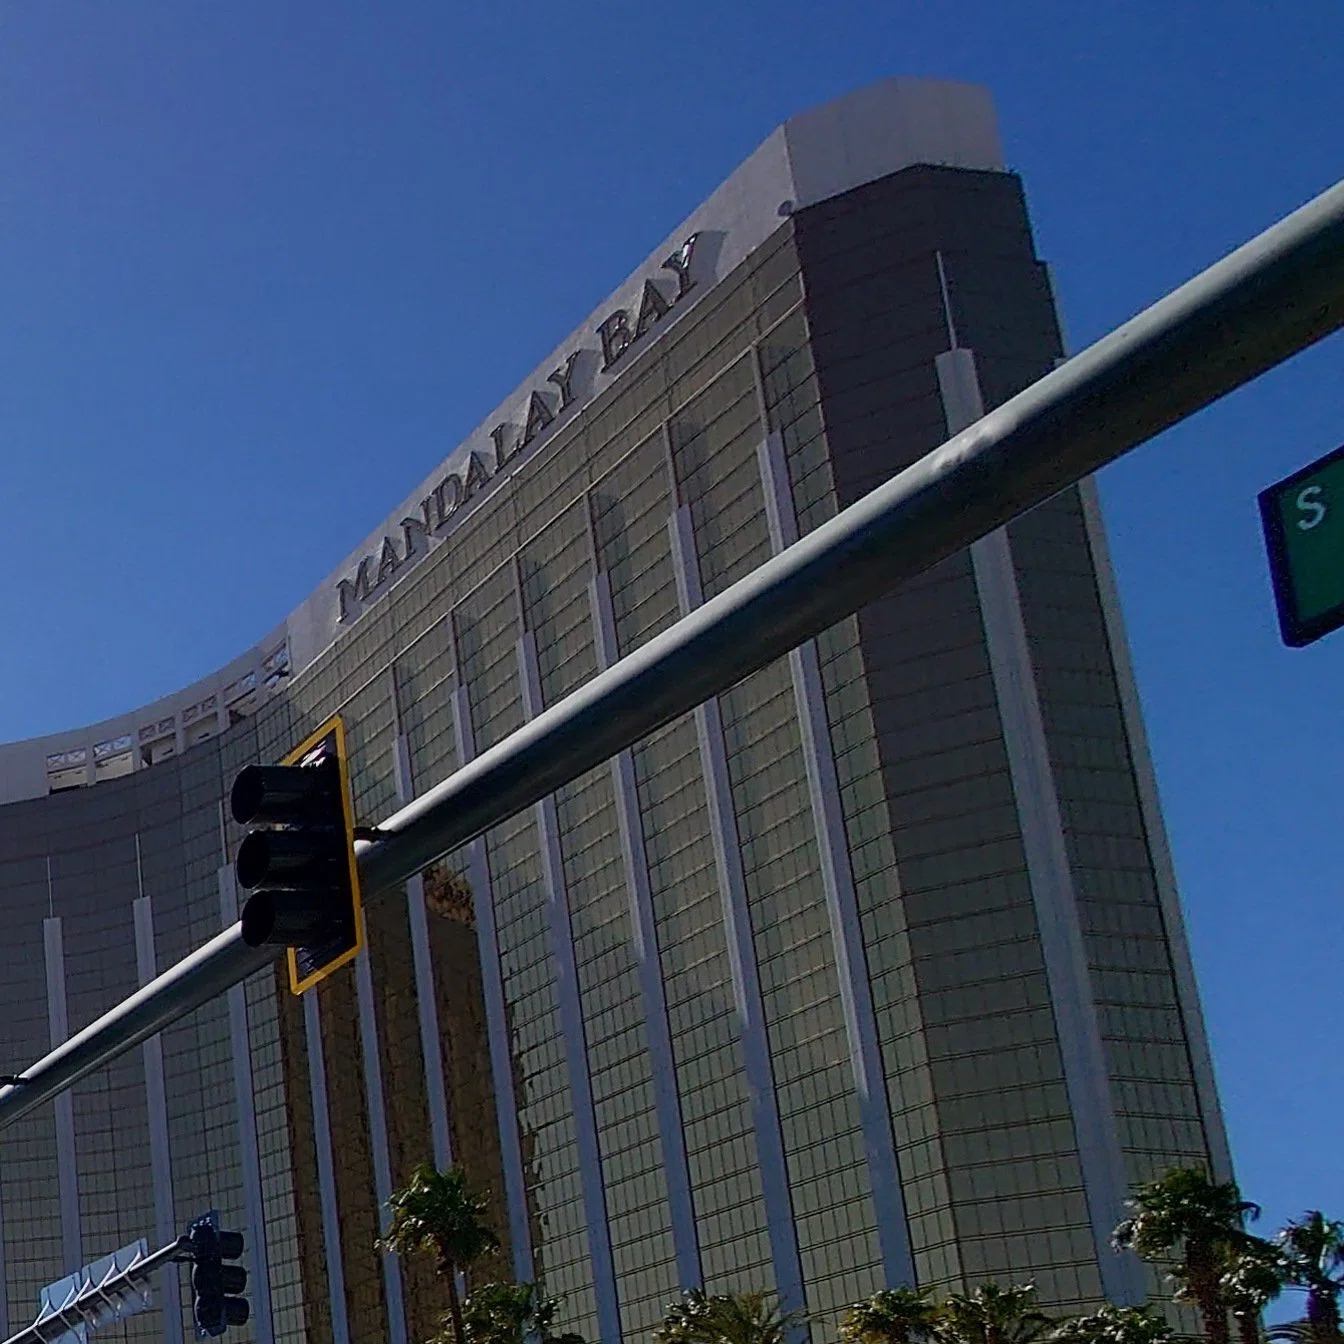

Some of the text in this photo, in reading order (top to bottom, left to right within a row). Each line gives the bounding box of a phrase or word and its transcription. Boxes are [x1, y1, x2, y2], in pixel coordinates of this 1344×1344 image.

[336, 231, 699, 624] MANDALAY BAY
[1296, 486, 1326, 530] S
